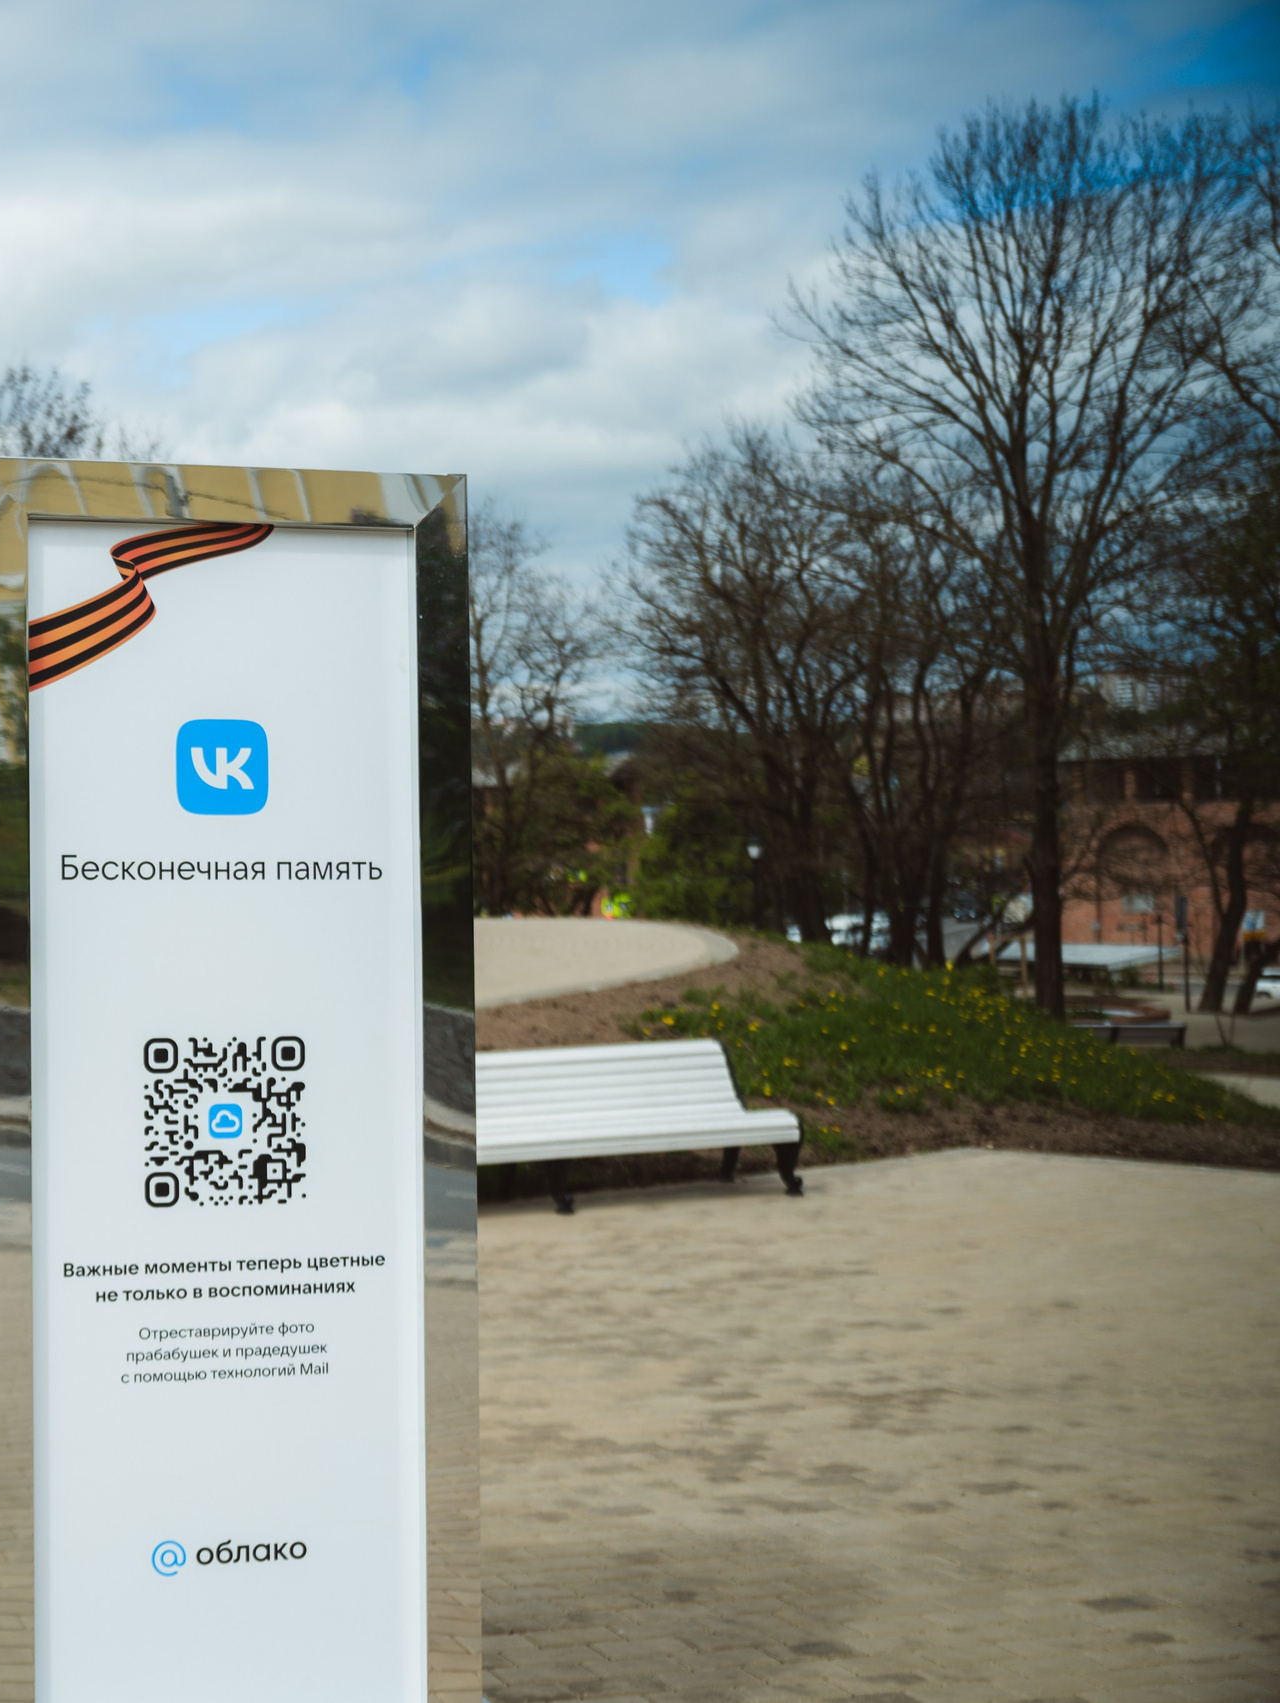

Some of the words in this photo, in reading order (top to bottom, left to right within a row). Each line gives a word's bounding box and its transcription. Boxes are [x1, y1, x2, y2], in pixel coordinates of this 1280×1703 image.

[190, 746, 255, 790] VK
[59, 854, 266, 881] Бесконечная
[276, 857, 384, 881] память
[63, 1262, 140, 1278] Важные
[144, 1259, 232, 1275] моменты
[236, 1257, 302, 1274] теперь
[307, 1254, 386, 1270] цветные
[95, 1288, 118, 1303] не
[122, 1285, 188, 1301] только
[193, 1285, 203, 1299] в
[208, 1281, 356, 1299] воспоминаниях
[138, 1323, 274, 1342] Отреставрируйте
[278, 1321, 315, 1337] фото
[126, 1347, 219, 1365] прабабушек
[222, 1348, 231, 1358] и
[235, 1343, 327, 1360] прадедушек
[121, 1373, 130, 1384] с
[133, 1369, 207, 1384] помощью
[210, 1363, 296, 1380] технологий
[299, 1362, 329, 1376] Mail
[195, 1538, 308, 1567] облако
